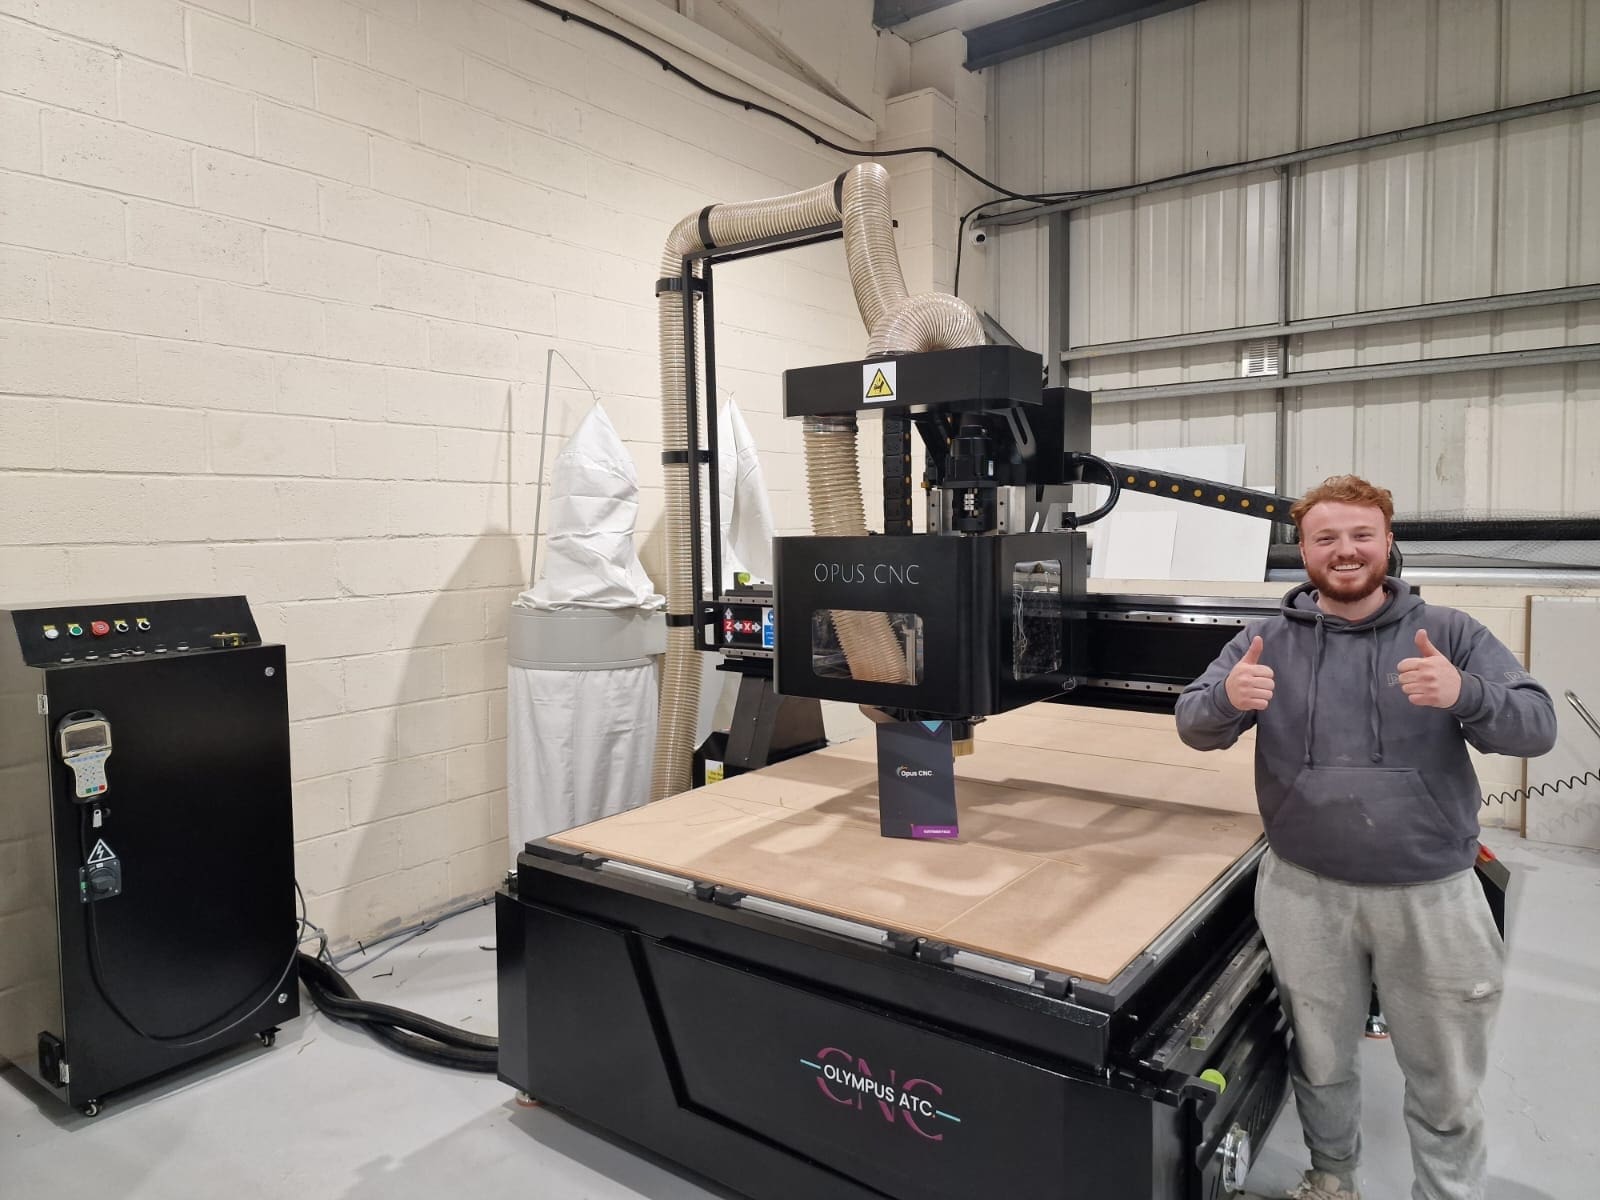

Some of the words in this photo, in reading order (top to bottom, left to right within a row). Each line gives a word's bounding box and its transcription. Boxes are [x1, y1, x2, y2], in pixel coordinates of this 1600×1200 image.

[814, 563, 865, 583] OPUS
[873, 564, 920, 585] CNC
[725, 621, 733, 630] Z
[743, 622, 752, 632] X
[900, 770, 917, 778] Opus
[823, 1064, 895, 1103] OLYMPUS
